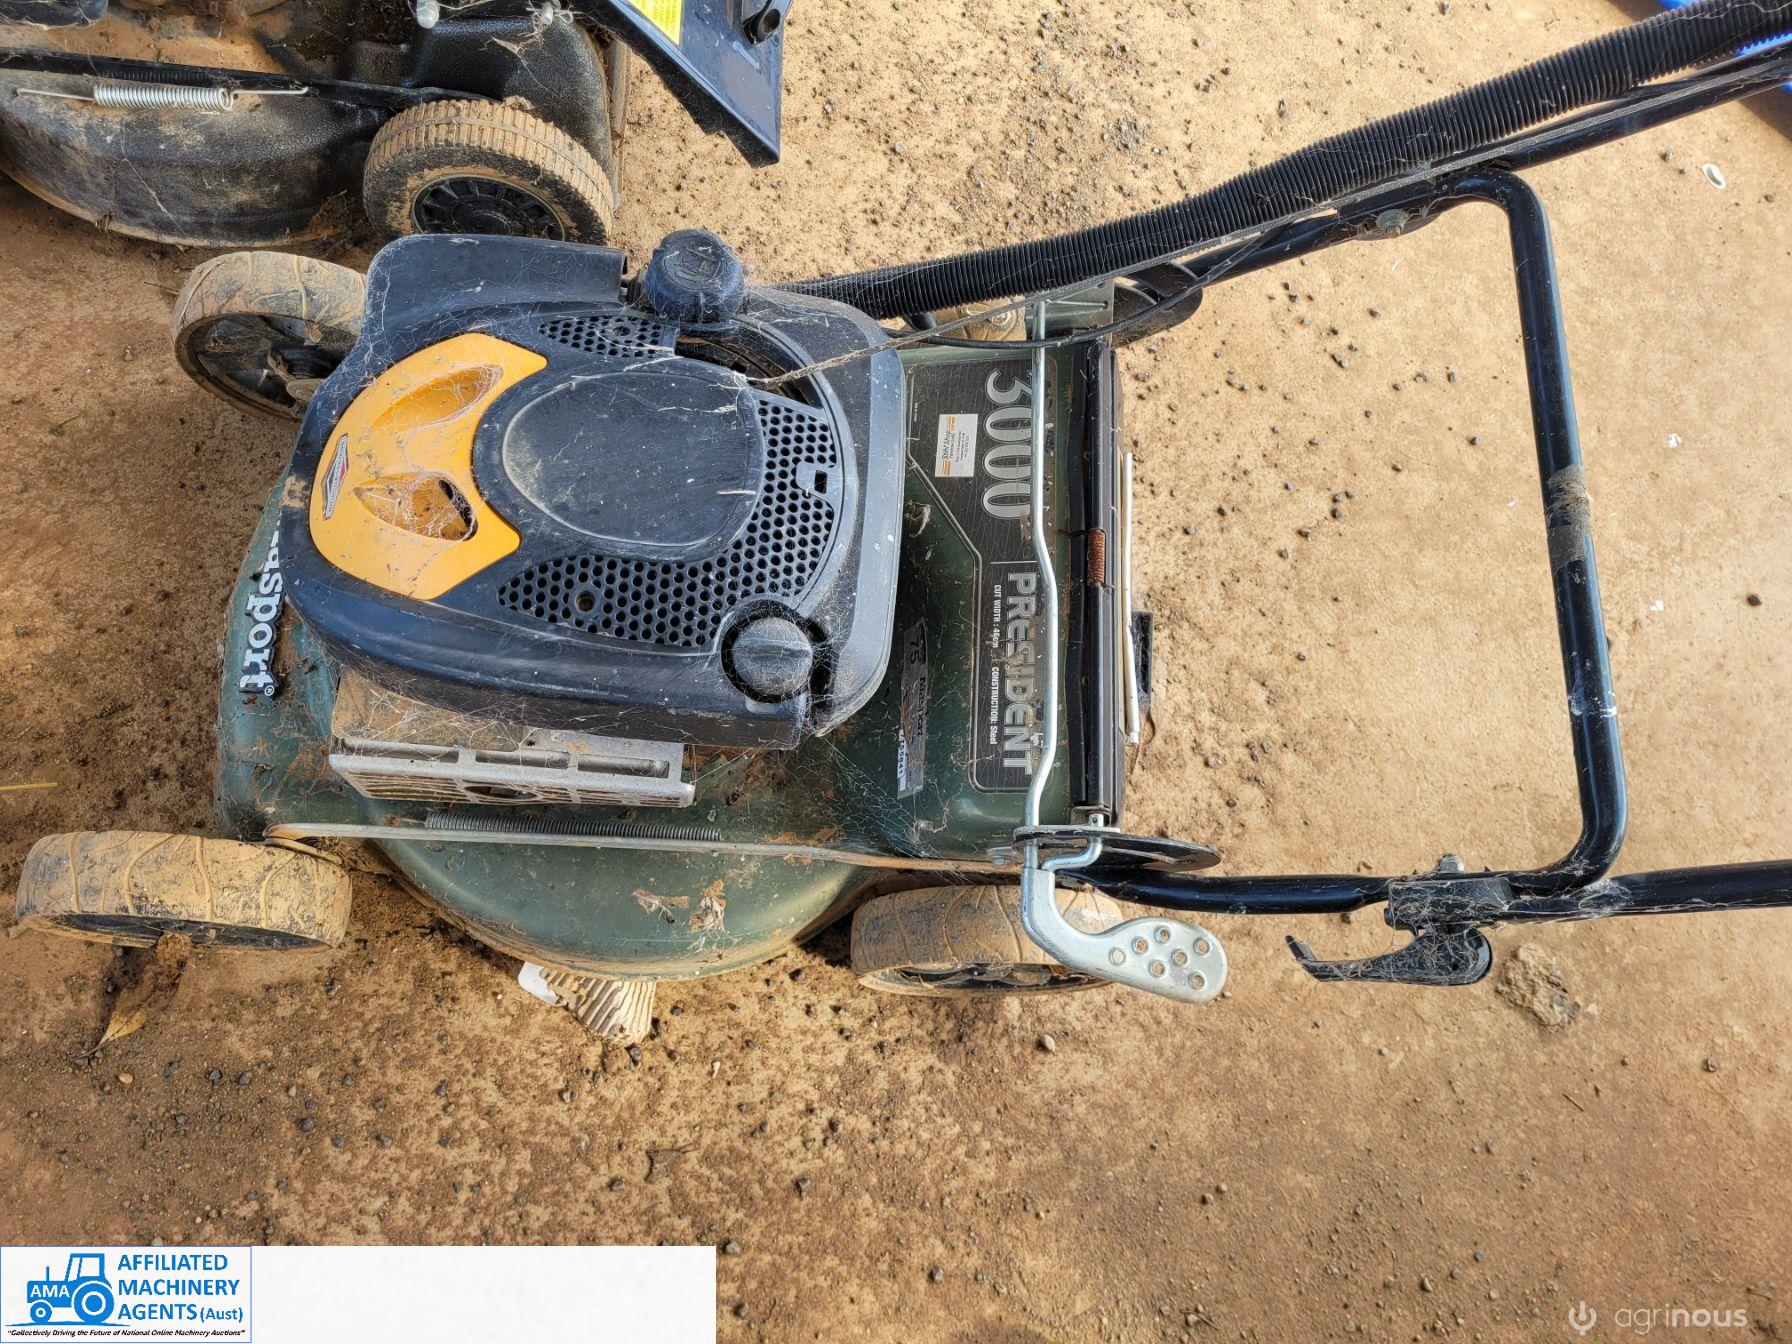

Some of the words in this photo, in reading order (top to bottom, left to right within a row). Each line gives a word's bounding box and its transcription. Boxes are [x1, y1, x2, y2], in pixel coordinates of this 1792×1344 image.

[993, 584, 1002, 599] CUT
[992, 600, 1001, 622] WIDTH
[991, 628, 1001, 648] 46cm
[909, 634, 921, 665] 75
[1003, 571, 1037, 775] PRESIDENT
[989, 666, 1000, 724] CONSTRUCTION:
[989, 725, 998, 745] Steel
